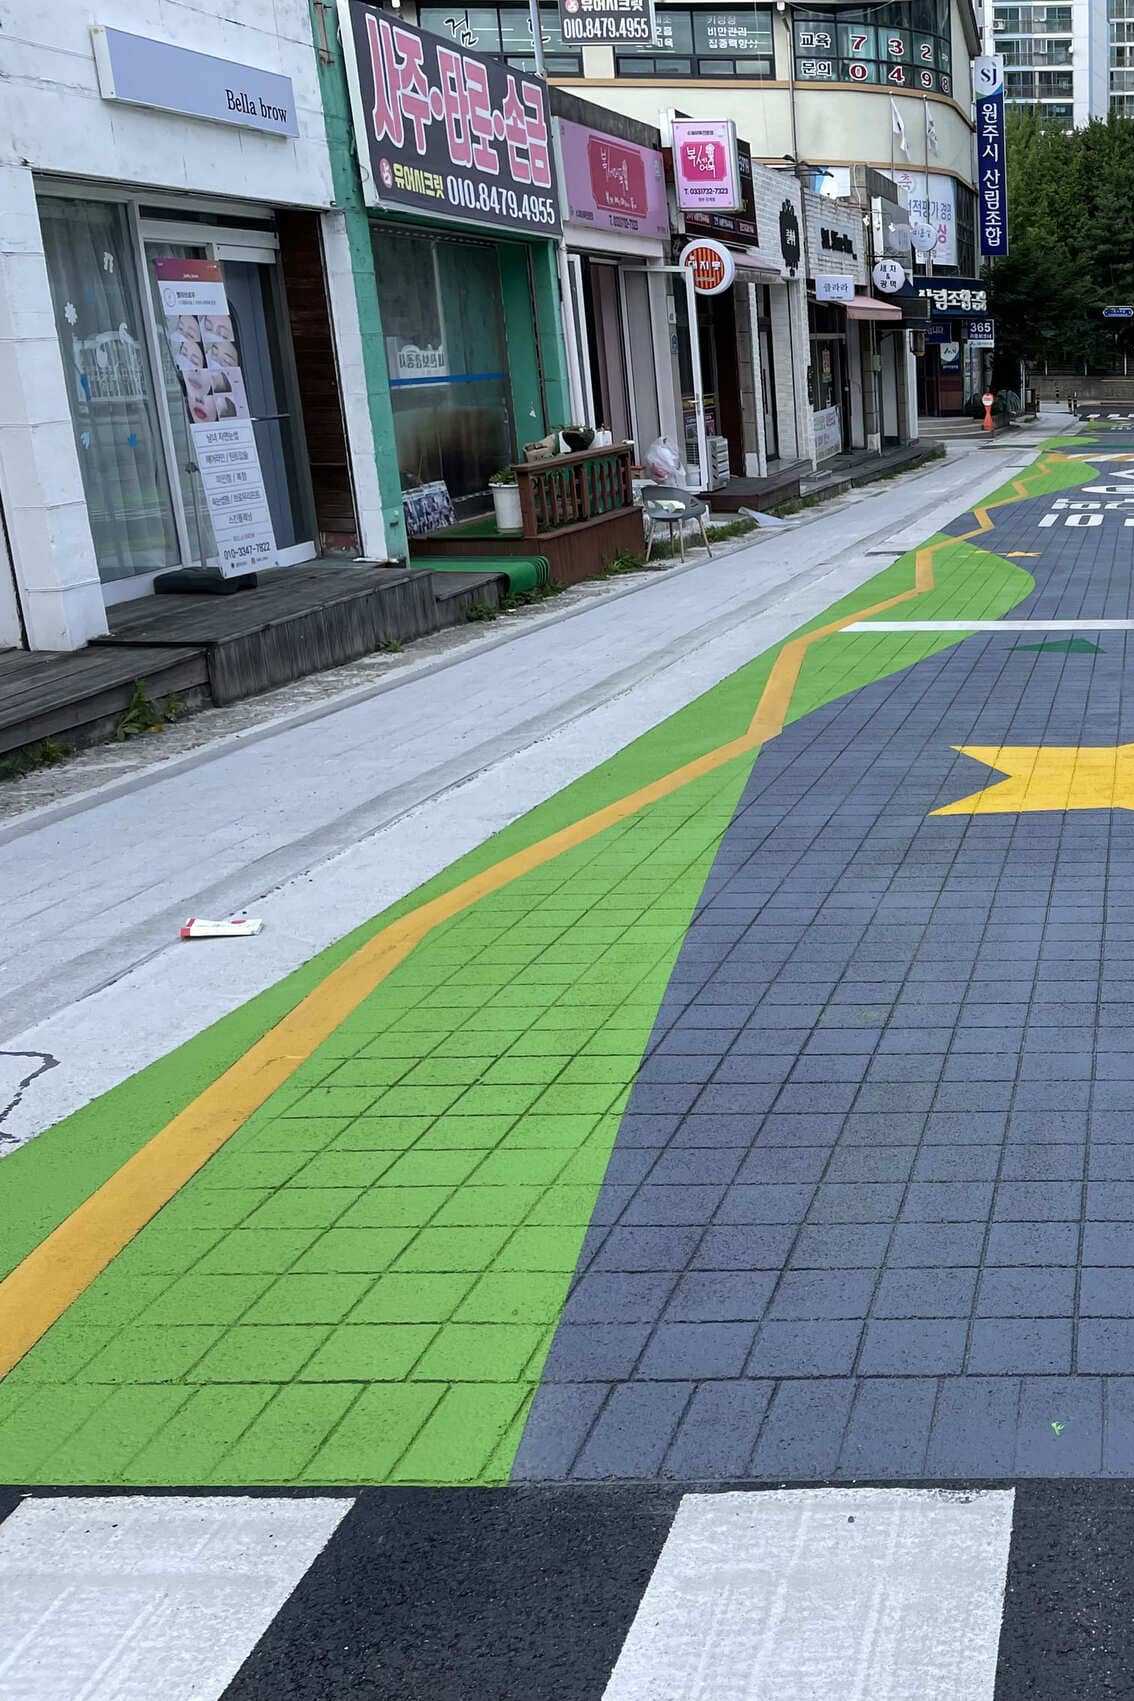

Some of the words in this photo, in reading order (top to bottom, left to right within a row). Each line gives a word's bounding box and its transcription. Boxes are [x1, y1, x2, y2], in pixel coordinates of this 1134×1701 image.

[563, 17, 649, 38] 010.8479.4955
[800, 32, 832, 48] 교육
[851, 35, 866, 51] 7
[888, 38, 904, 55] 3
[920, 43, 932, 61] 2
[801, 60, 832, 77] 문의
[850, 64, 867, 80] 0
[888, 66, 904, 82] 4
[921, 71, 932, 88] 9
[225, 88, 257, 116] Bella
[259, 96, 288, 123] brow
[982, 103, 1000, 163] 원주시
[393, 162, 445, 199] 유어시크릿
[446, 175, 556, 225] 010.8479.4955
[983, 168, 1003, 247] 산림조합
[970, 322, 991, 332] 365
